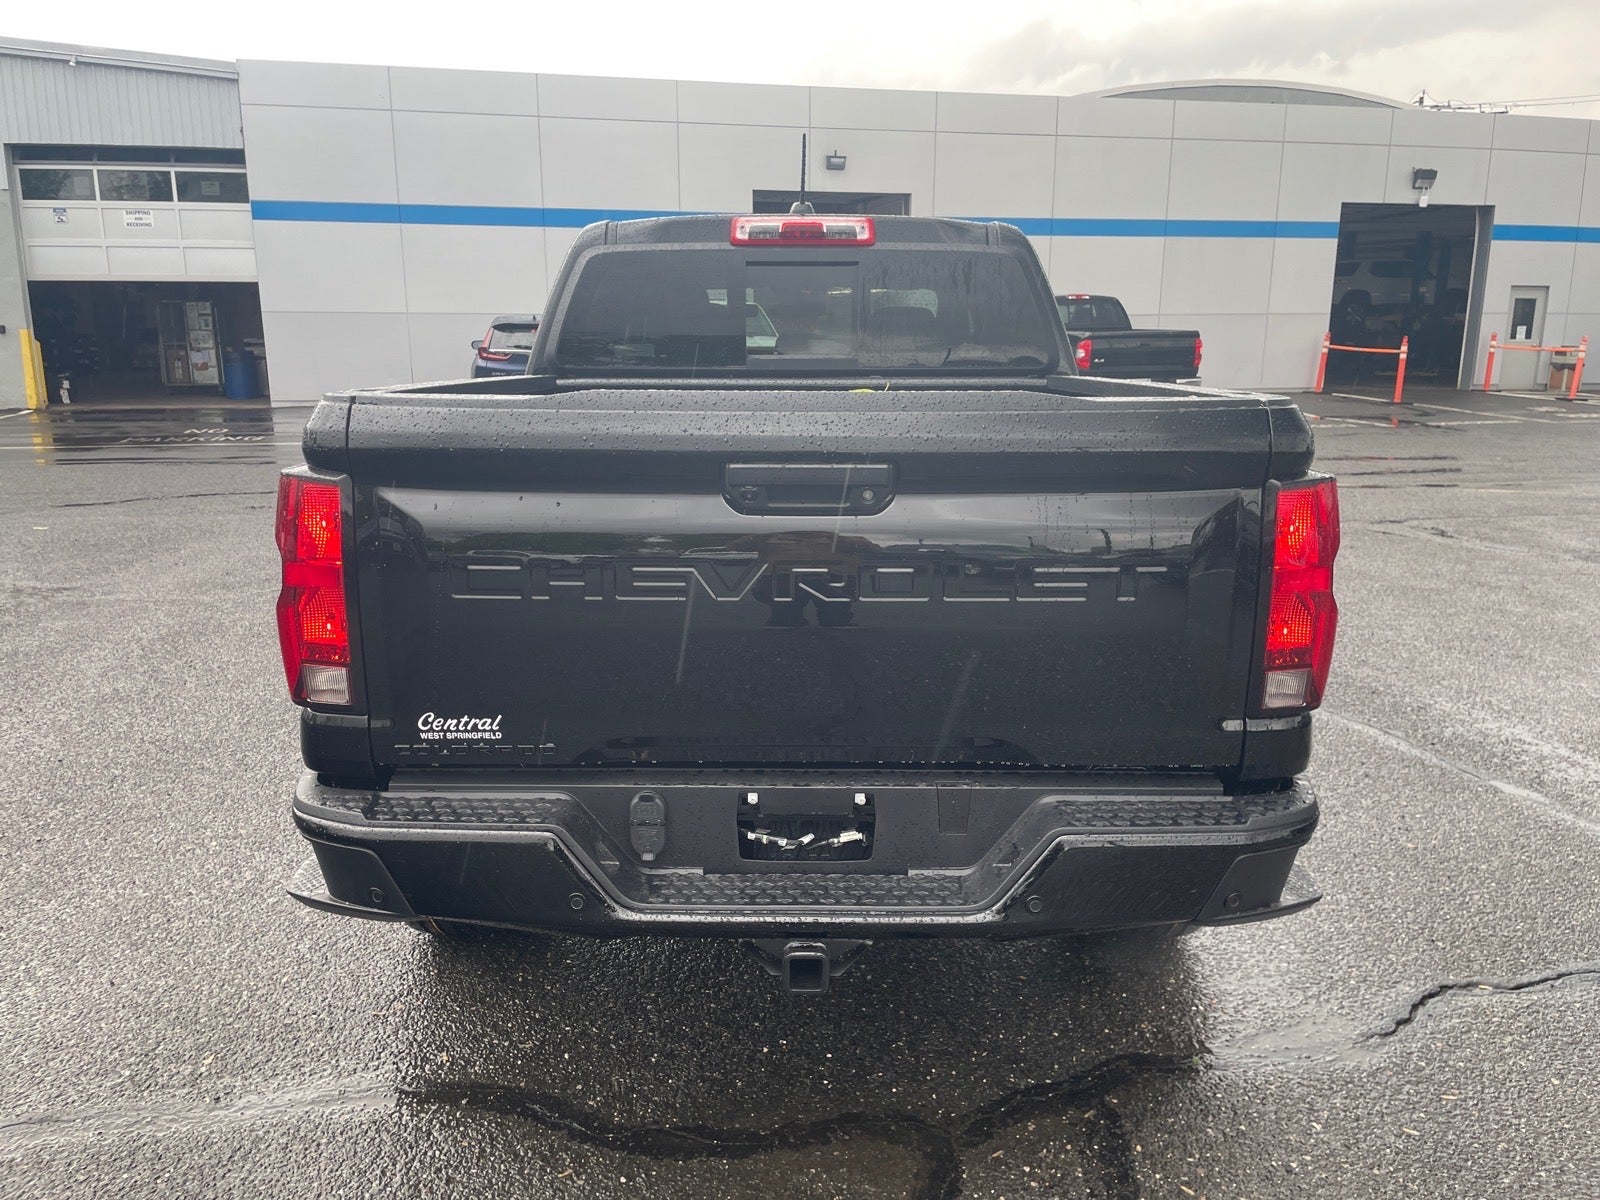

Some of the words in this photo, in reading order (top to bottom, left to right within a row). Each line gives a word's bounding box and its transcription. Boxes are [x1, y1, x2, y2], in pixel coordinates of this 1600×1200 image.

[450, 557, 1169, 602] CHEVROLET
[417, 711, 502, 731] Central
[420, 732, 444, 740] WEST
[446, 732, 502, 740] SPRINGFIELD
